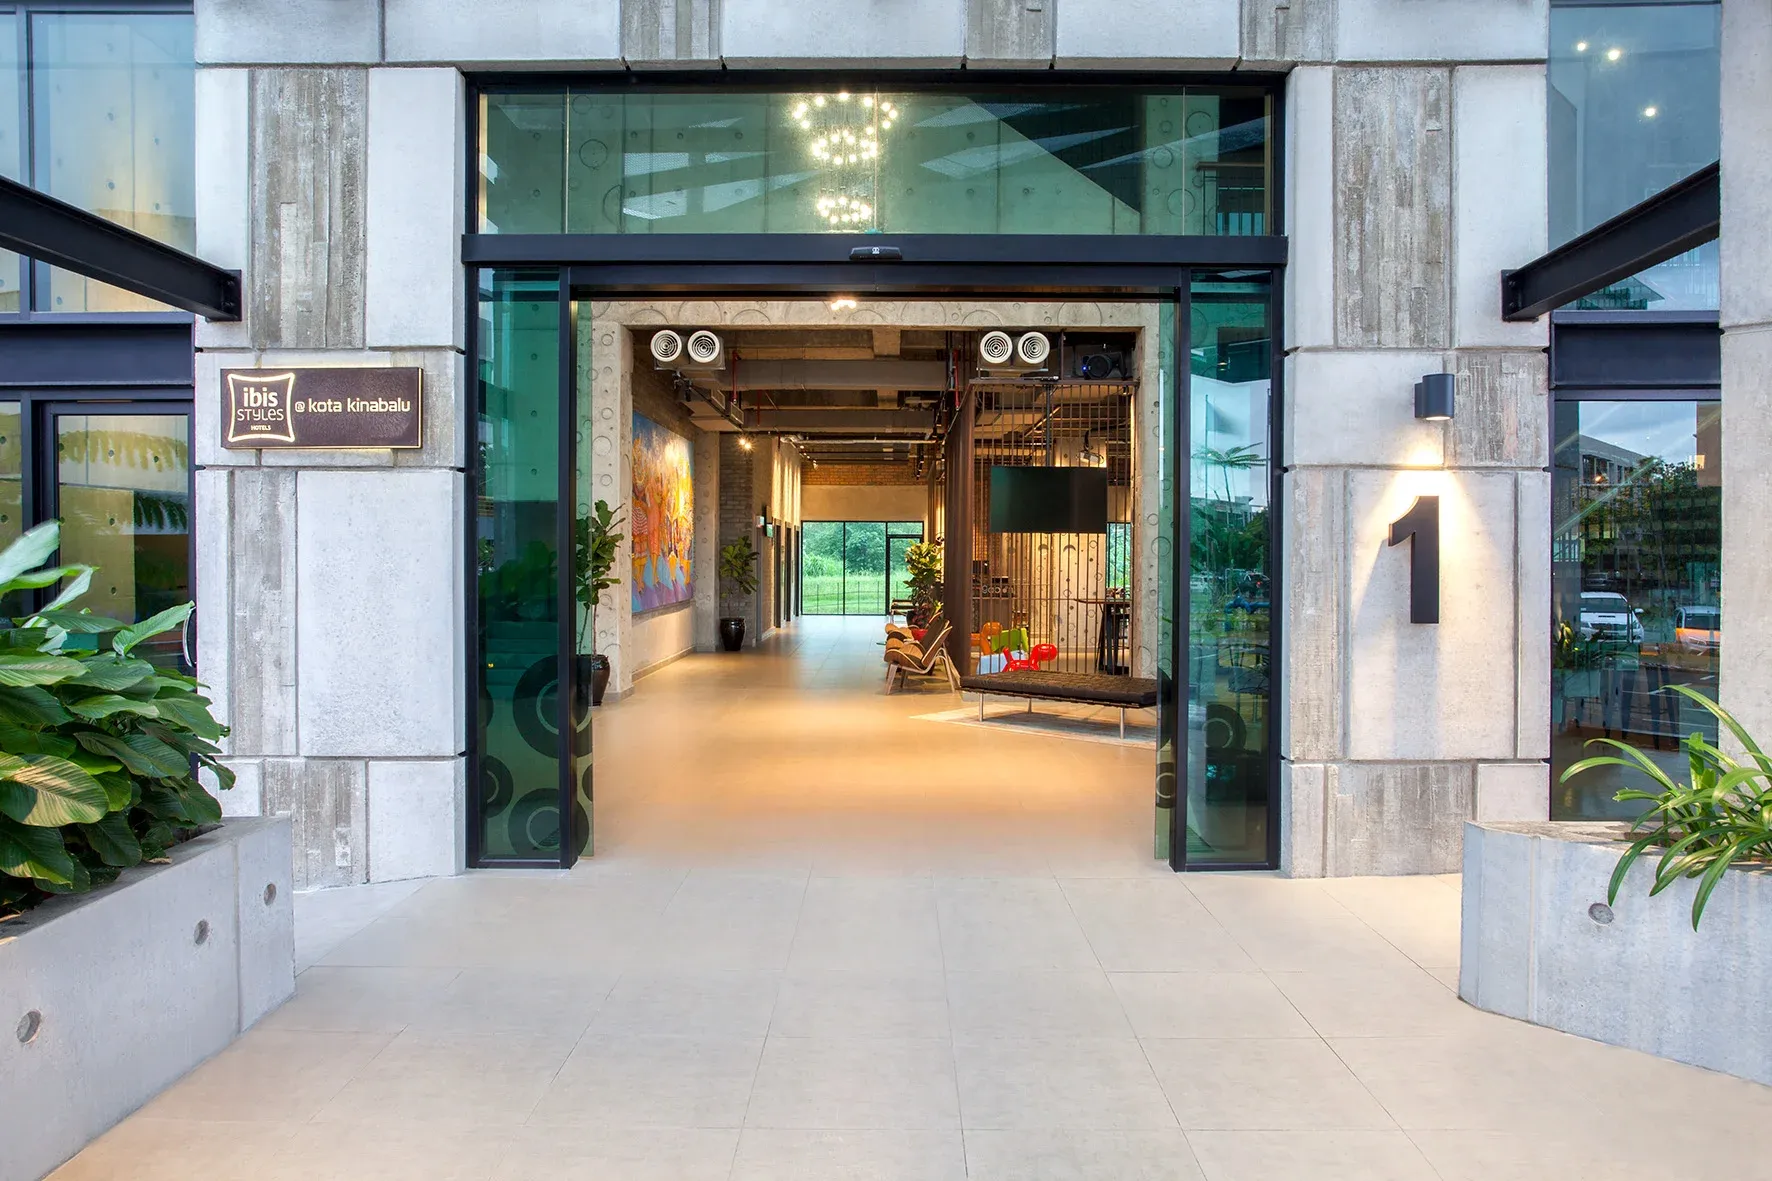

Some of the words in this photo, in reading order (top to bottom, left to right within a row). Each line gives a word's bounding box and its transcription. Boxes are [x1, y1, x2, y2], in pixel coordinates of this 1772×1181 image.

[243, 387, 278, 408] ibis
[295, 401, 305, 413] @
[308, 398, 342, 413] kota
[347, 397, 411, 413] kinabalu
[237, 408, 284, 421] STYLES
[1388, 496, 1439, 623] 1
